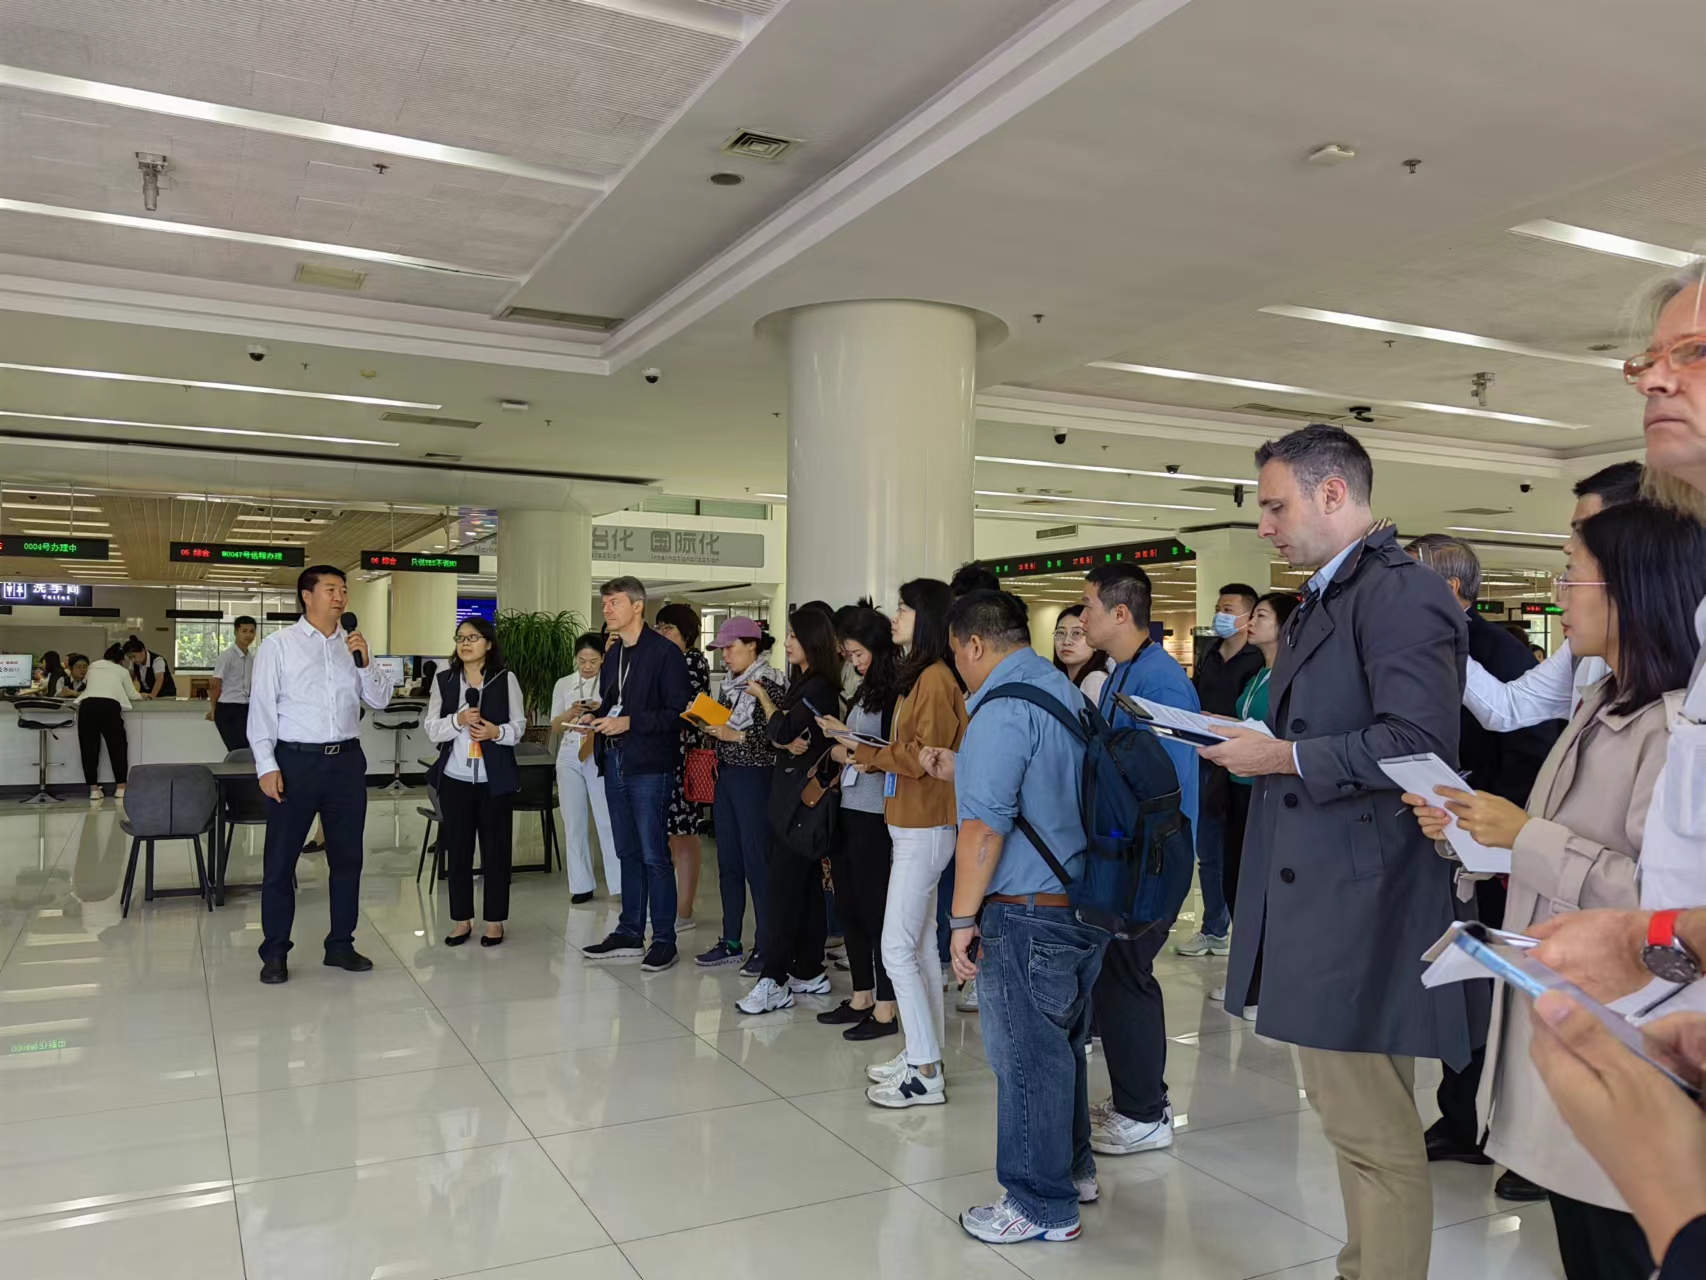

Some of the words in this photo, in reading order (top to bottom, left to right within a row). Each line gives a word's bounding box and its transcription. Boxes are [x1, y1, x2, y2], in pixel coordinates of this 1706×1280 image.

[650, 530, 720, 556] 国际化
[33, 583, 80, 596] 洗手间
